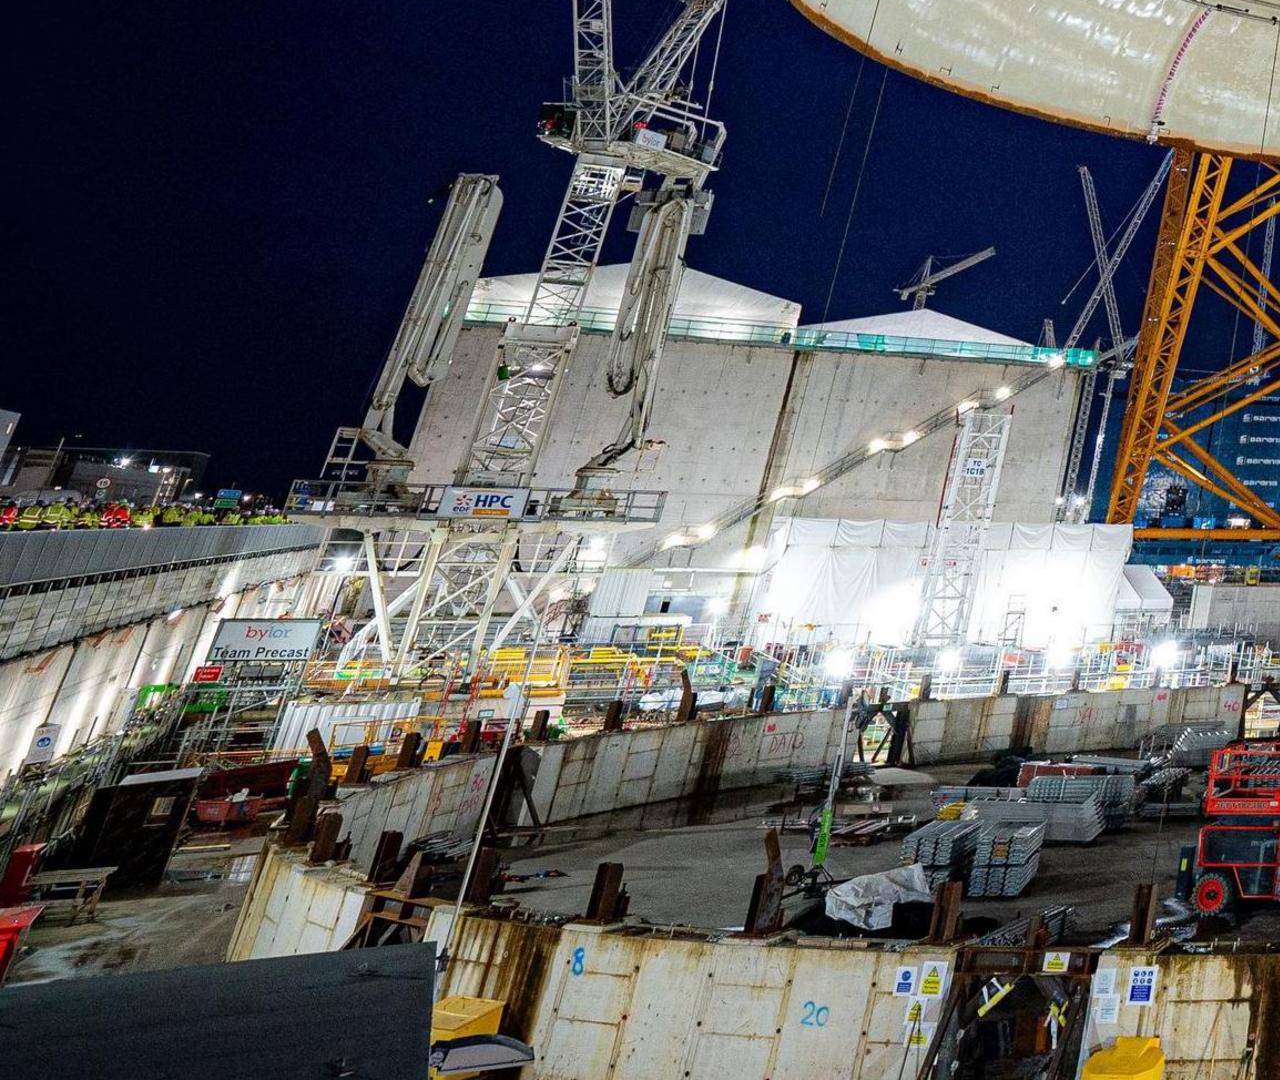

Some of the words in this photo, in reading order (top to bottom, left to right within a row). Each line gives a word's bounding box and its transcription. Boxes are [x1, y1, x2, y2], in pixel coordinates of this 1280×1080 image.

[474, 494, 514, 509] HPC
[245, 626, 292, 641] bylor
[214, 647, 250, 659] Team
[255, 647, 310, 659] Precast
[571, 946, 585, 976] 8
[800, 1000, 830, 1027] 20
